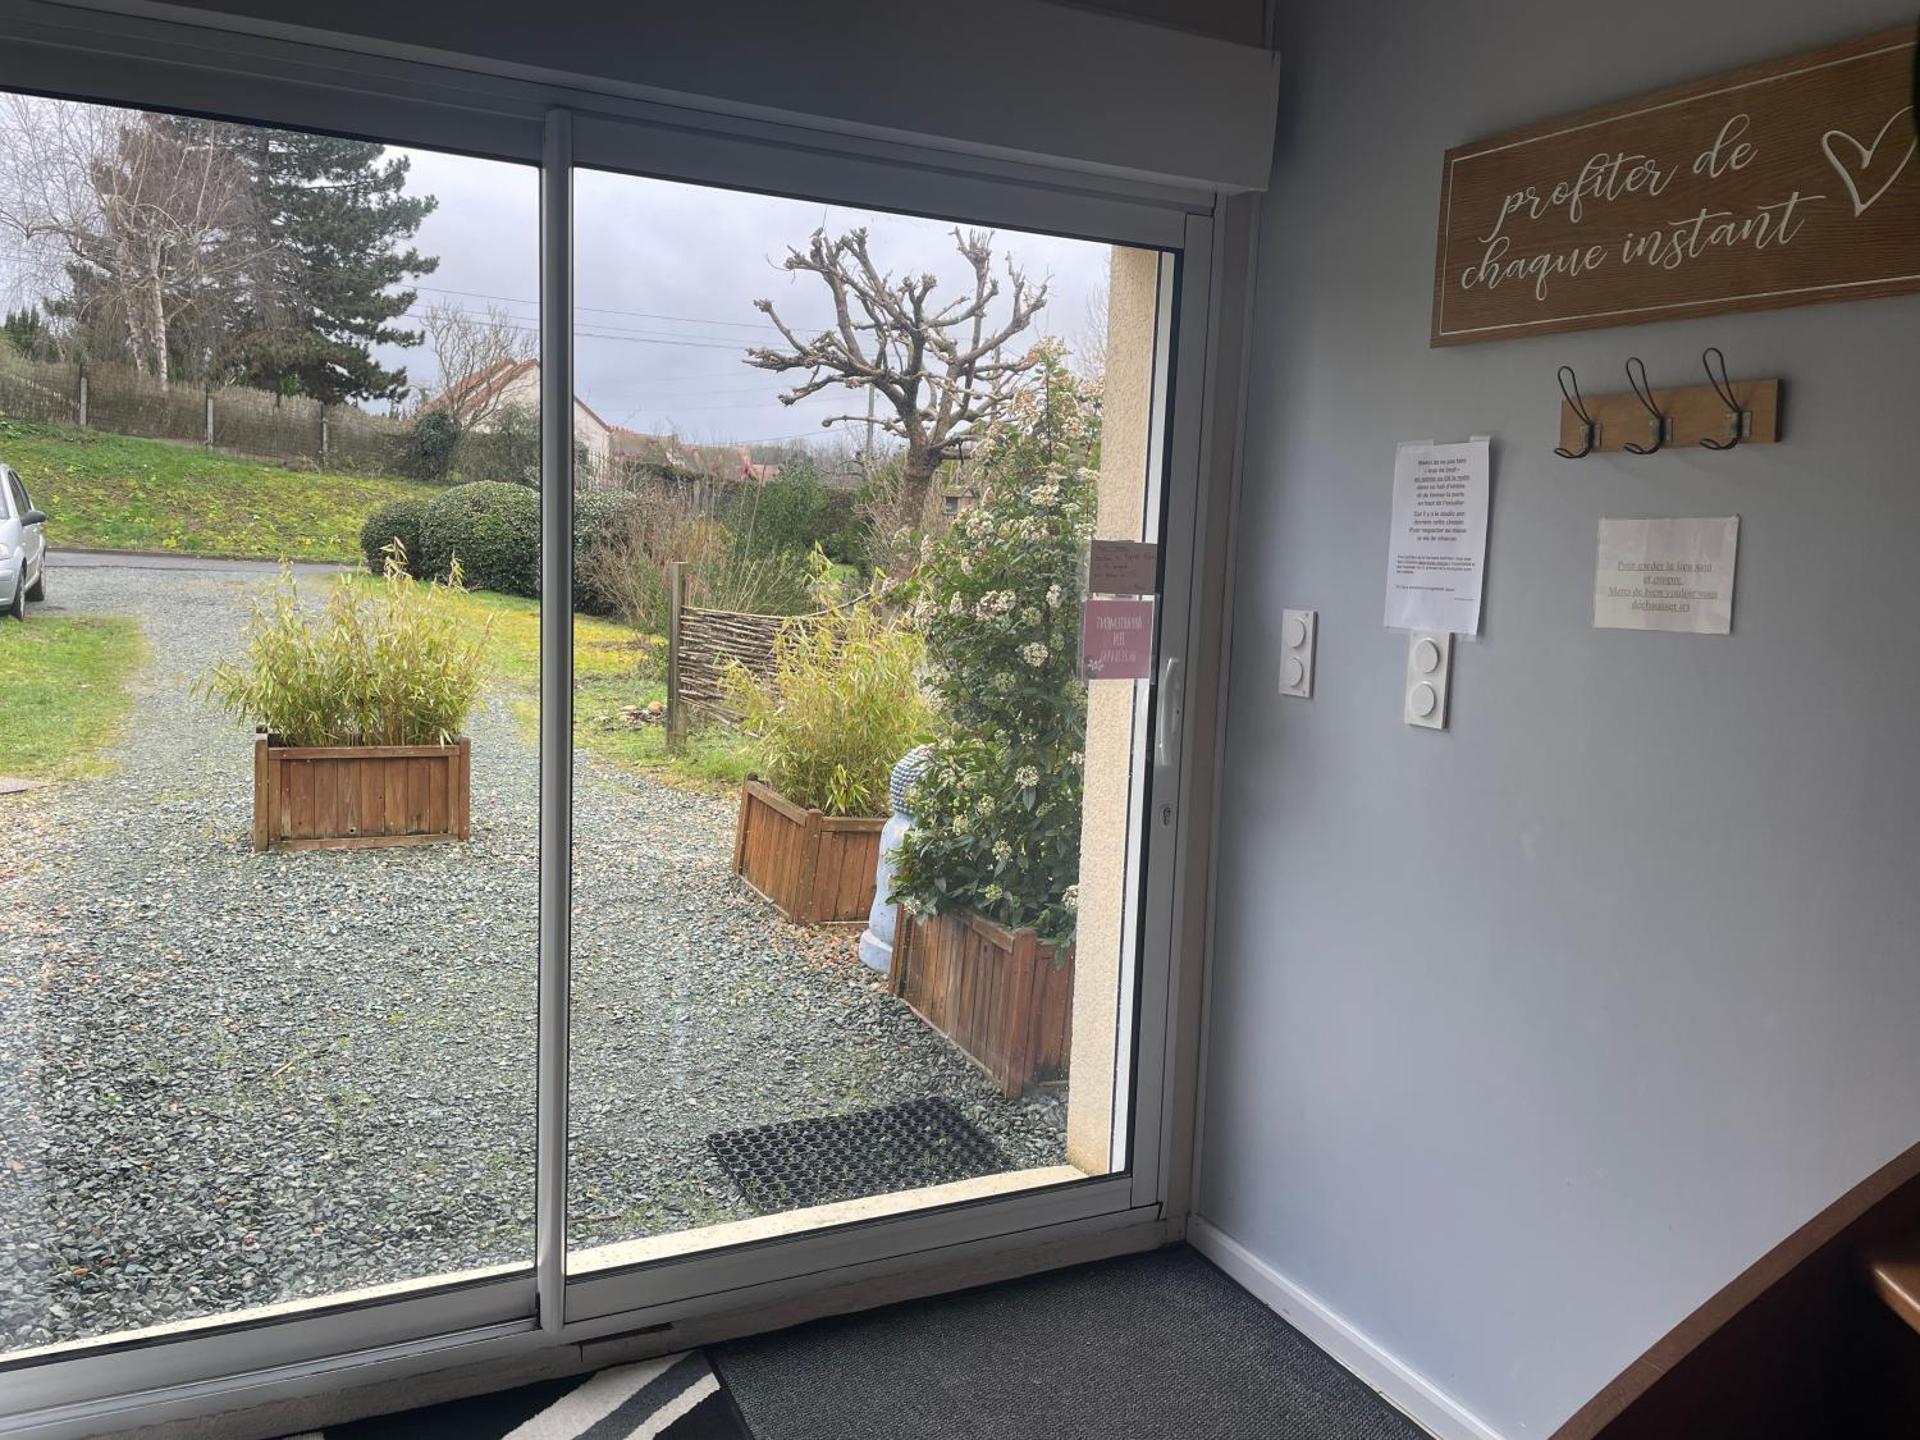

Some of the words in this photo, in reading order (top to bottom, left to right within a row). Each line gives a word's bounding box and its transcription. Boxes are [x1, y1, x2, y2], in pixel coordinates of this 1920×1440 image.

[1477, 151, 1679, 243] profiter
[1693, 113, 1758, 178] de
[1461, 236, 1609, 301] chaque
[1622, 191, 1827, 270] instant
